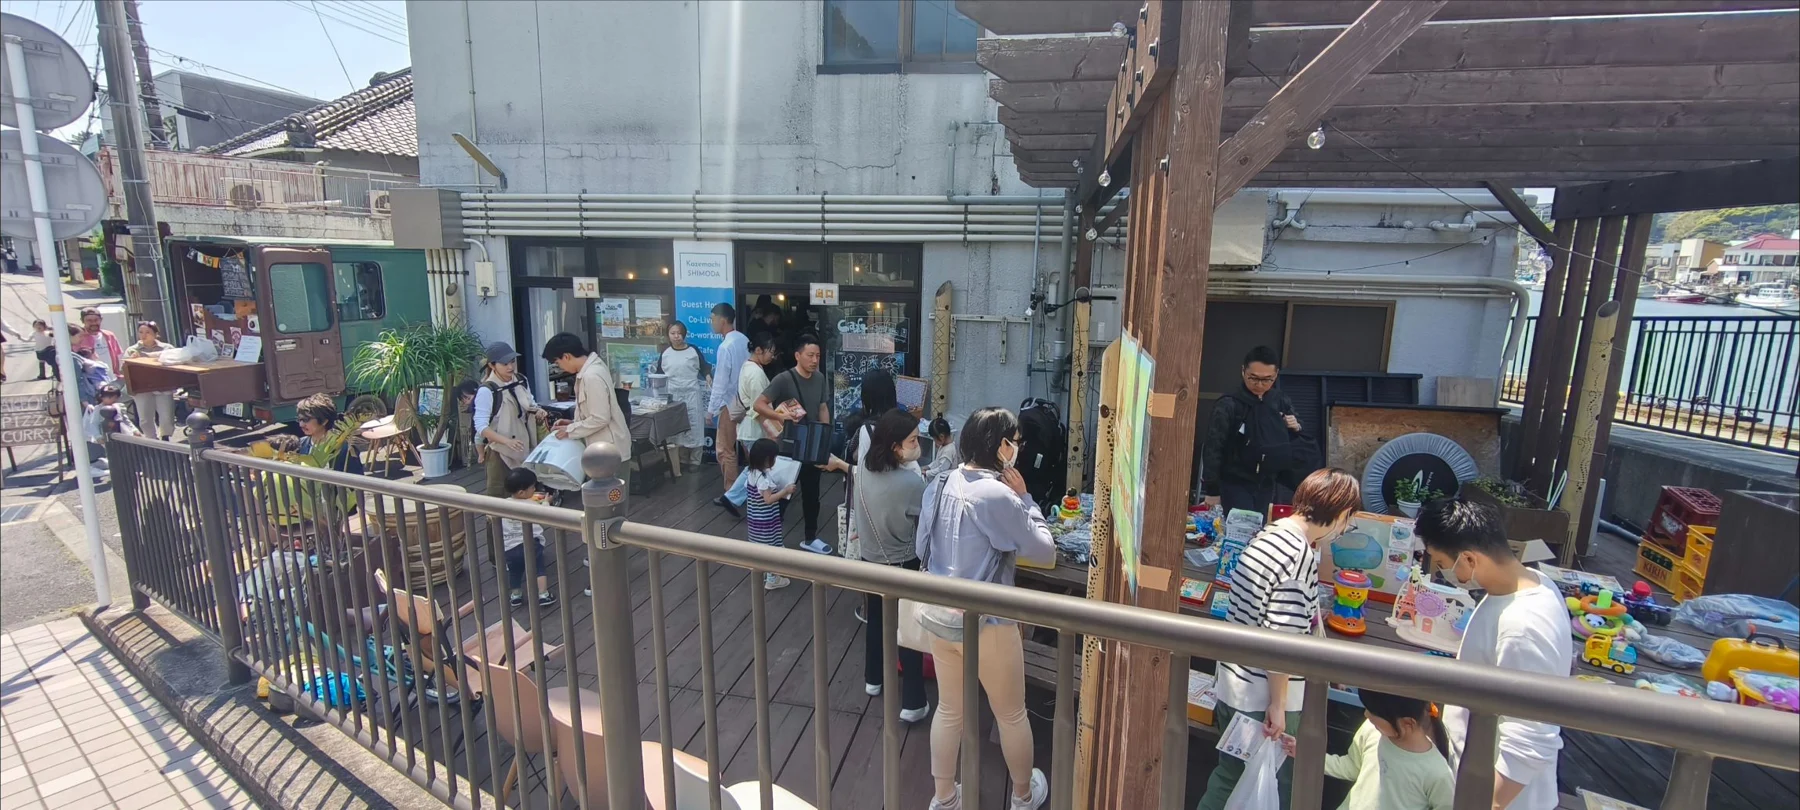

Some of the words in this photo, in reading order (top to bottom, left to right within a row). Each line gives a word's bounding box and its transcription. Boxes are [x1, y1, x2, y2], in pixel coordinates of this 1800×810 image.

[578, 283, 594, 291] 入口
[815, 289, 834, 298] 出口
[681, 300, 702, 308] Guest
[2, 415, 55, 428] PIZZA
[2, 427, 54, 443] CURRY
[1643, 561, 1667, 581] KIRIN
